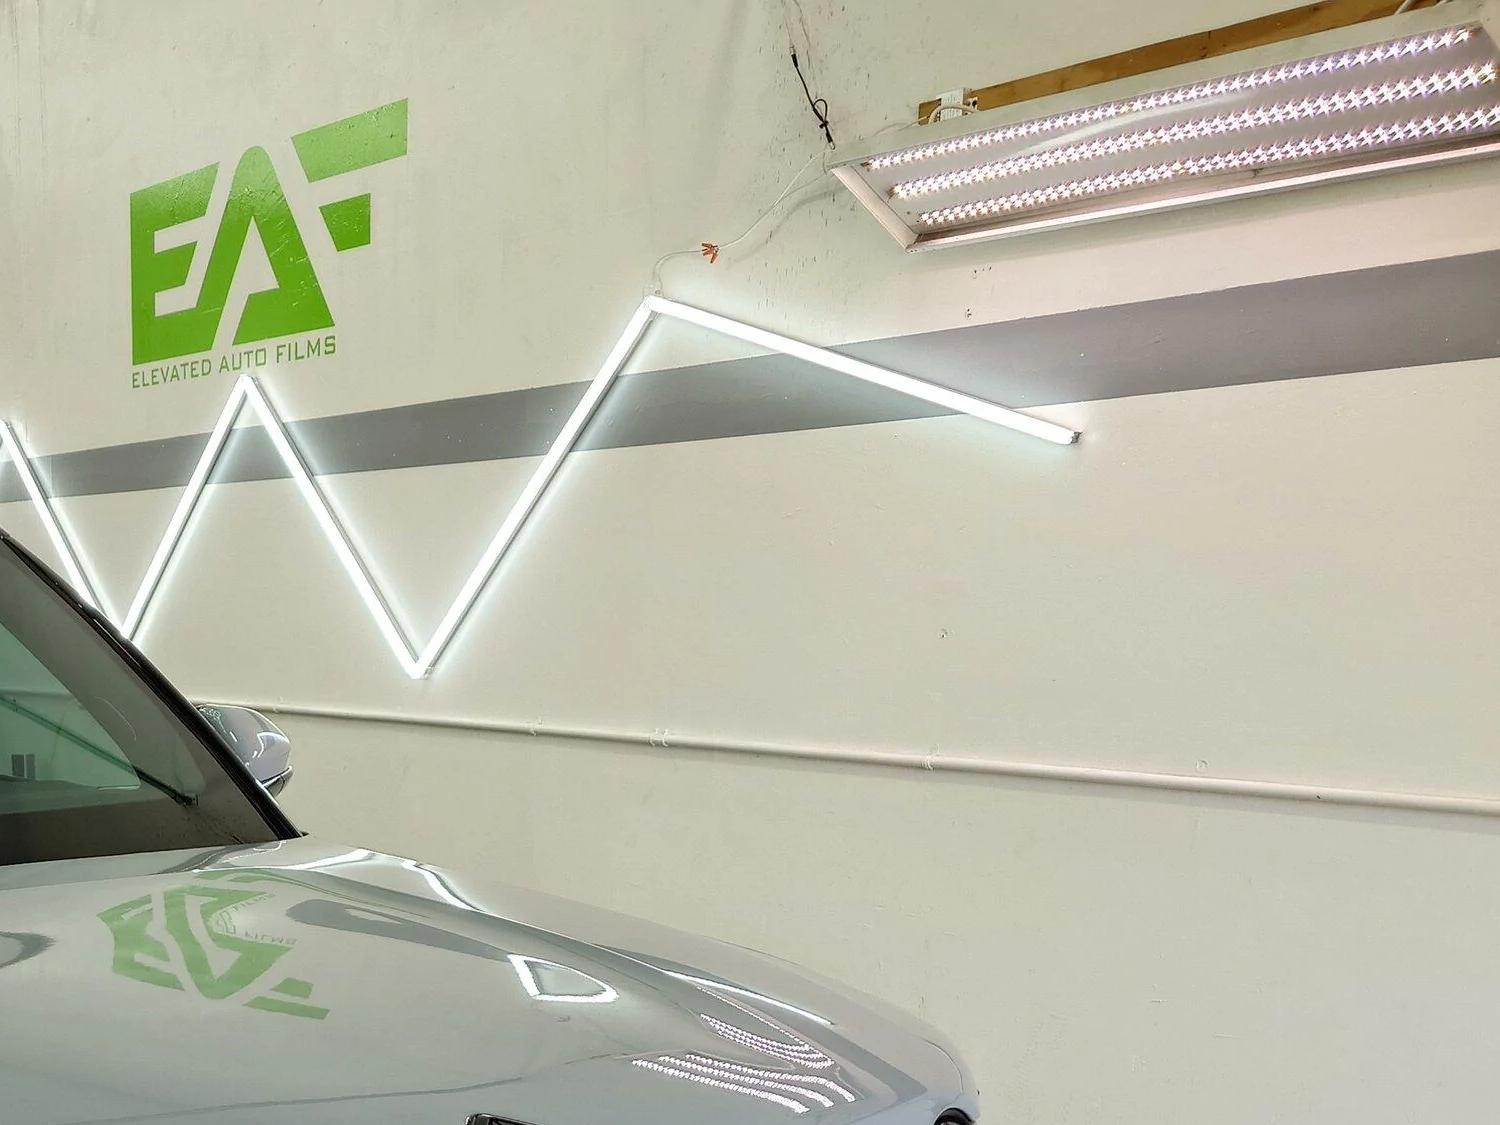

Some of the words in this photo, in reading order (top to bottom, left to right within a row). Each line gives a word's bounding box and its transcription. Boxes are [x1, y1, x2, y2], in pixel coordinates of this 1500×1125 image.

[129, 97, 409, 366] EAF
[131, 359, 212, 389] ELEVATED
[218, 348, 267, 374] AUTO
[276, 335, 337, 364] FILMS
